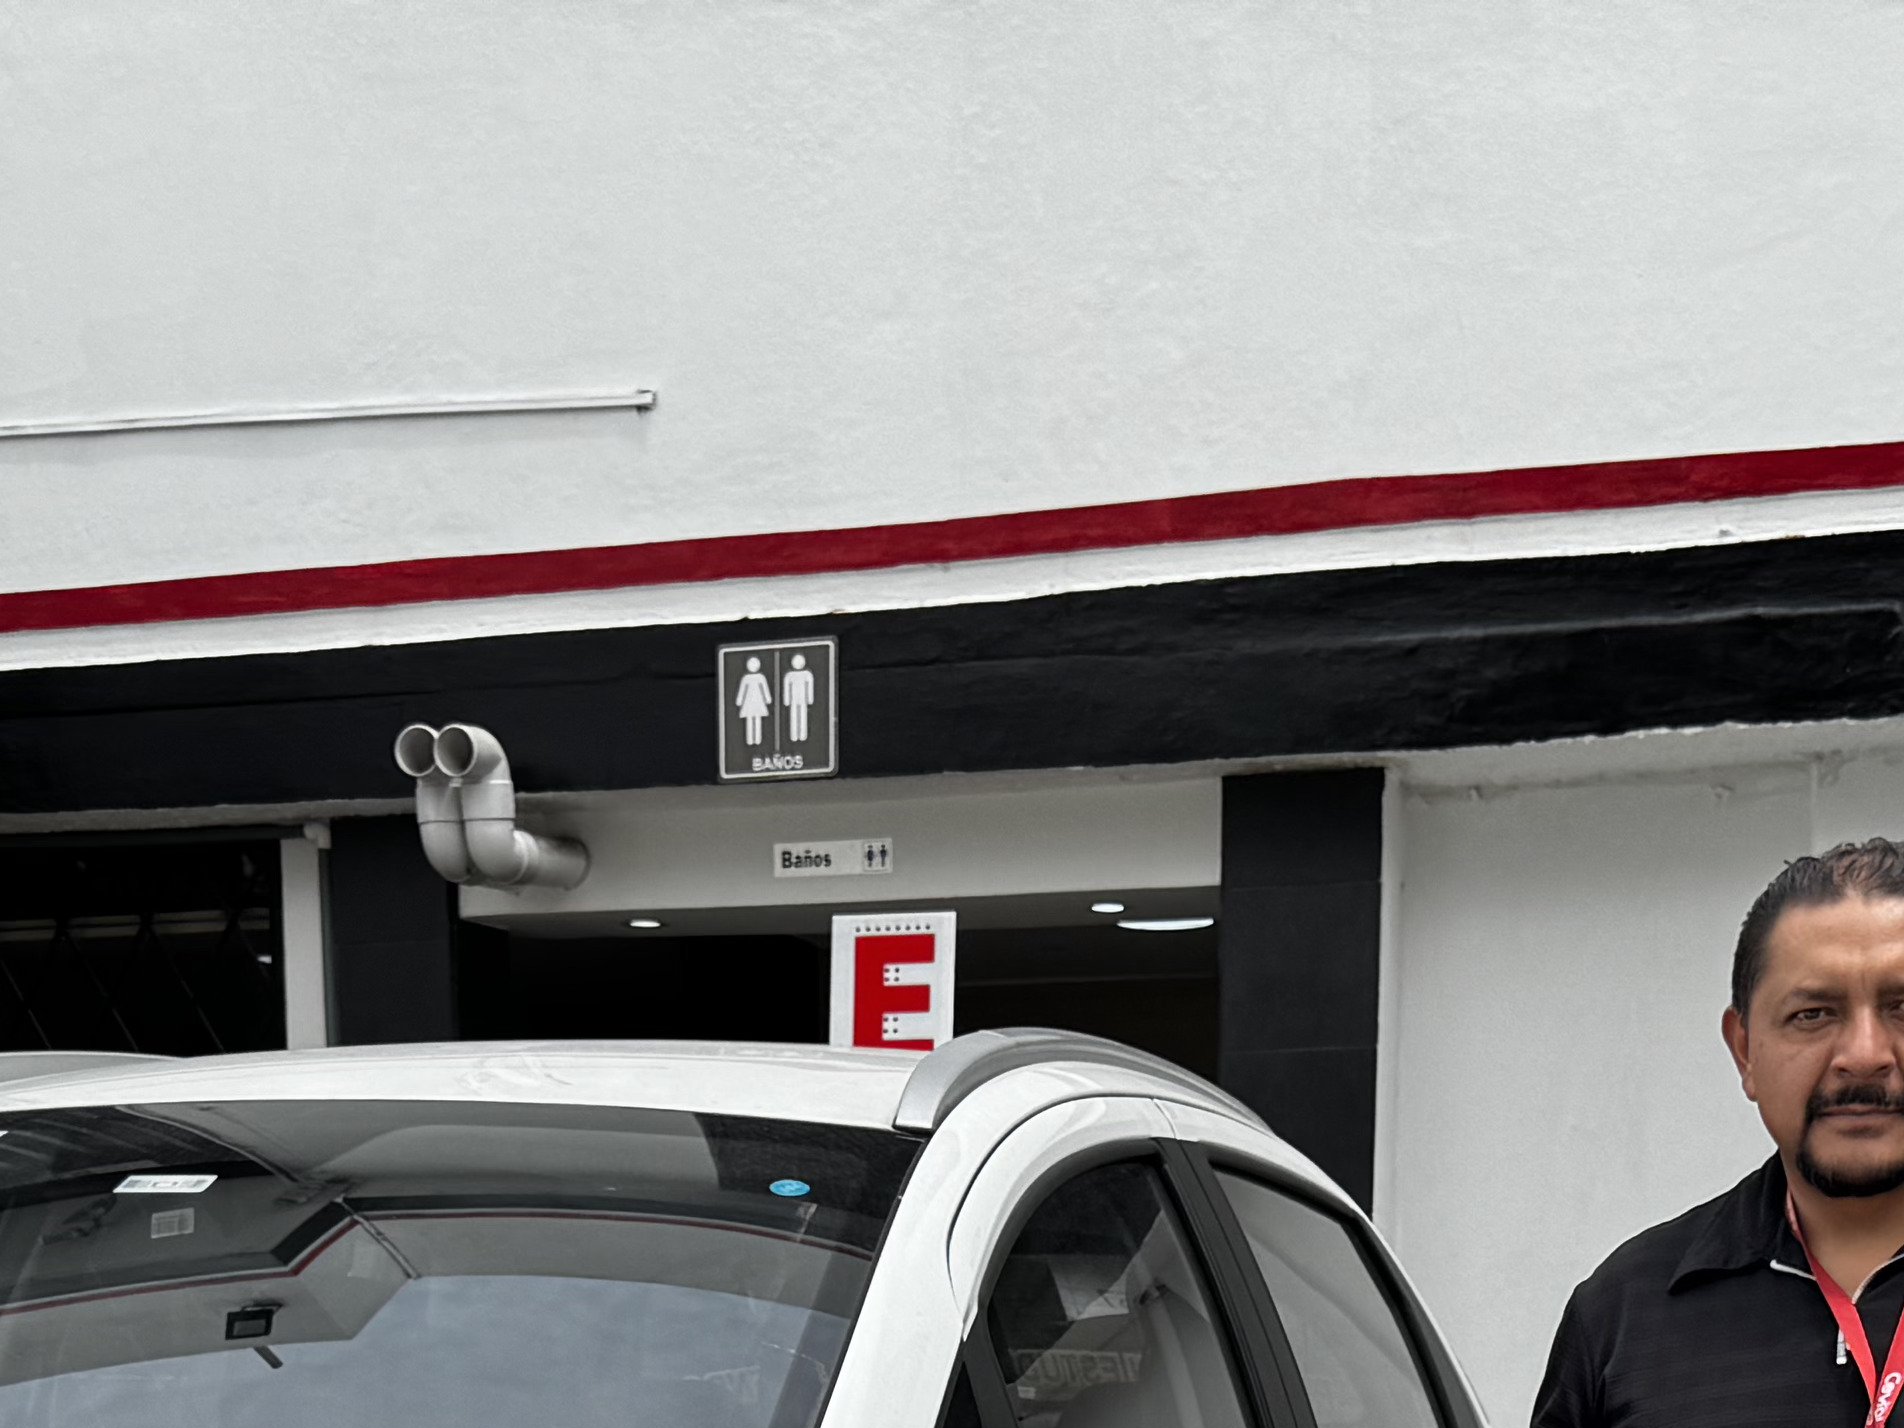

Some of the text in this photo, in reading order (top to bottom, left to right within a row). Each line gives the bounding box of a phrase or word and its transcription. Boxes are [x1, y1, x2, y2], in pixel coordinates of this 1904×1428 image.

[751, 754, 804, 772] BAÑOS
[781, 849, 832, 869] Baños
[853, 933, 936, 1052] E
